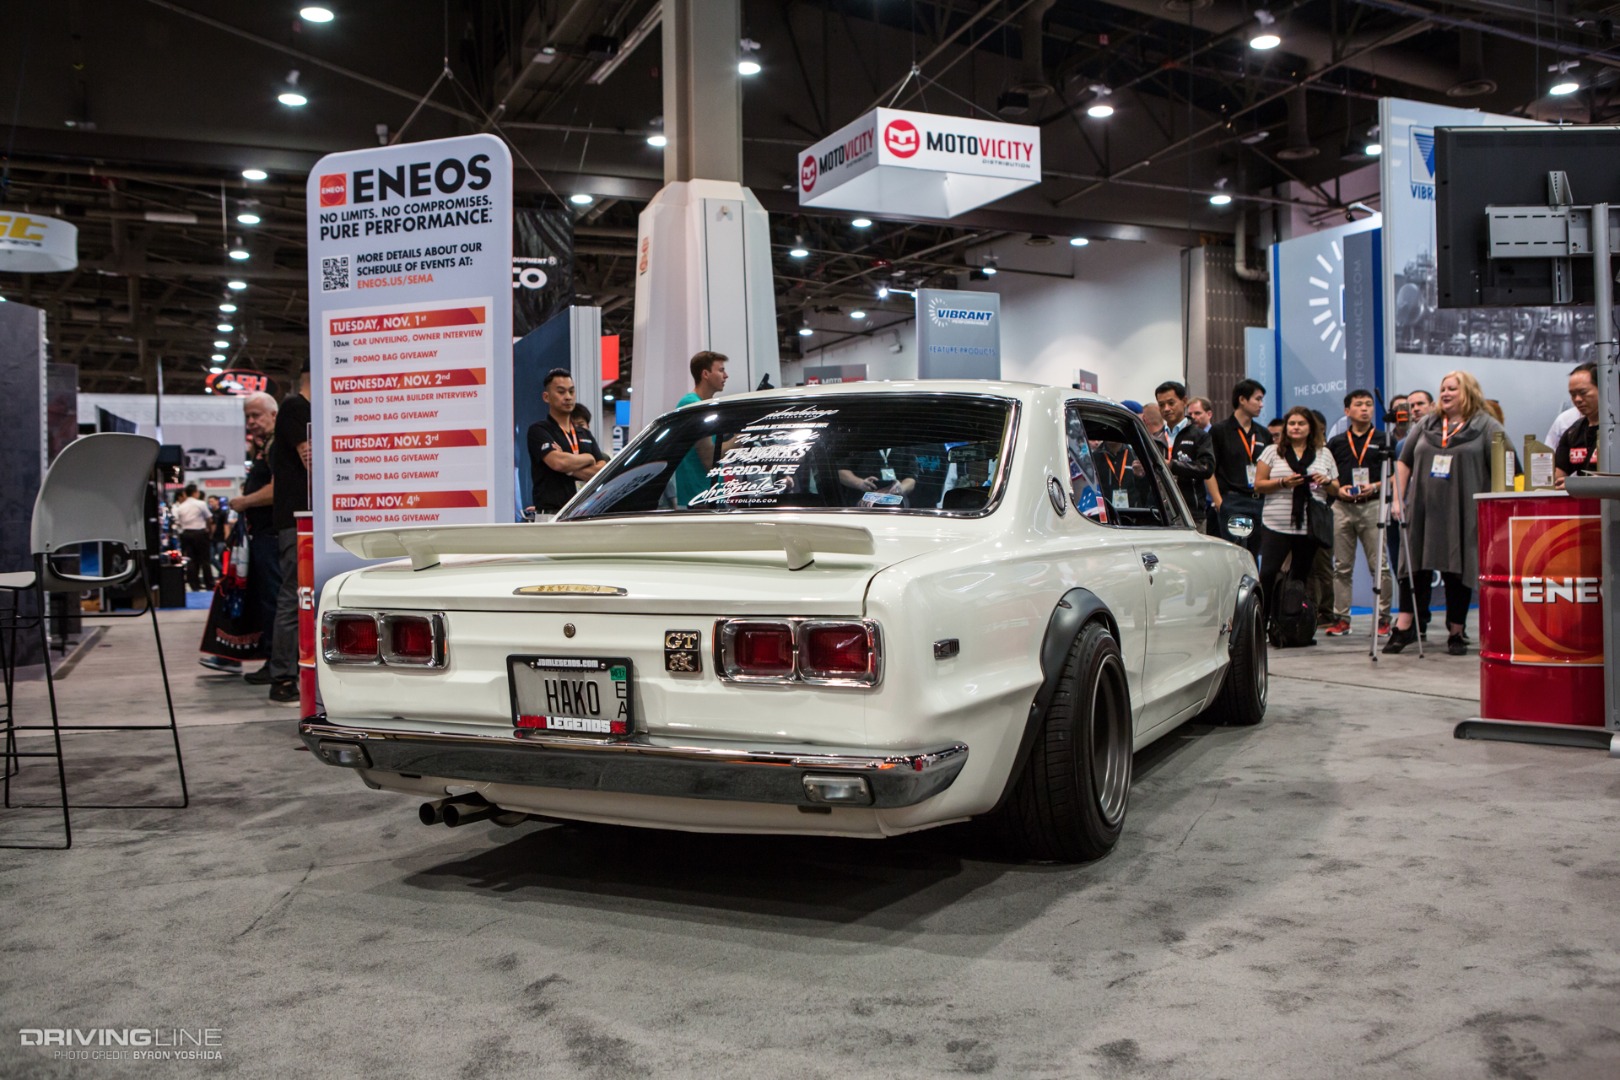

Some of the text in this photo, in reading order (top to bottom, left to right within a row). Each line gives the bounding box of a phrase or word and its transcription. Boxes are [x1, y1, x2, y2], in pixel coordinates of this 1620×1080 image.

[819, 127, 874, 176] MOTOVICITY
[926, 131, 1034, 162] MOTOVICITY
[982, 159, 1031, 168] DISTRIBUTION
[353, 153, 492, 204] ENEOS
[321, 185, 345, 195] ENEOS
[1410, 184, 1436, 200] VIBR
[320, 195, 493, 225] NO LIMITS. NO COMPROMISES.
[320, 208, 493, 241] PURE PERFORMANCE.
[356, 242, 482, 263] MORE DETAILS ABOUT OUR
[357, 256, 473, 276] SCHEDULE OF EVENTS AT:
[357, 273, 434, 289] ENEOS.US/SEMA
[937, 308, 993, 321] VIBRANT
[332, 315, 427, 333] TUESDAY, NOV. 1st
[353, 338, 367, 346] CAR
[369, 335, 410, 345] UNVEILING,
[412, 332, 441, 342] OWNER
[443, 329, 483, 340] INTERVIEW
[353, 353, 381, 363] PROMO
[382, 352, 398, 361] BAG
[400, 350, 438, 360] GIVEAWAY
[929, 345, 996, 356] FEATURE PRODUCTS
[333, 372, 450, 391] WEDNESDAY, NOV. 2nd
[354, 396, 374, 405] ROAD
[386, 394, 405, 403] SEMA
[406, 393, 434, 402] BUILDER
[436, 390, 478, 400] INTERVIEWS
[1294, 384, 1310, 397] THE
[354, 412, 381, 422] PROMO
[383, 411, 398, 421] BAG
[400, 410, 439, 420] GIVEAWAY
[334, 434, 439, 450] THURSDAY, NOV. 3rd
[354, 455, 381, 464] PROMO
[383, 454, 399, 463] BAG
[401, 453, 439, 462] GIVEAWAY
[354, 472, 382, 481] PROMO
[383, 472, 399, 480] BAG
[401, 471, 439, 479] GIVEAWAY
[706, 465, 799, 477] #GRIDLIFE
[335, 494, 420, 509] FRIDAY, NOV. 4th
[355, 515, 382, 523] PROMO
[384, 514, 400, 522] BAG
[401, 513, 440, 522] GIVEAWAY
[1521, 577, 1602, 603] ENE
[665, 632, 697, 649] GT
[544, 679, 601, 716] HAKO
[546, 716, 611, 733] LEGENDS
